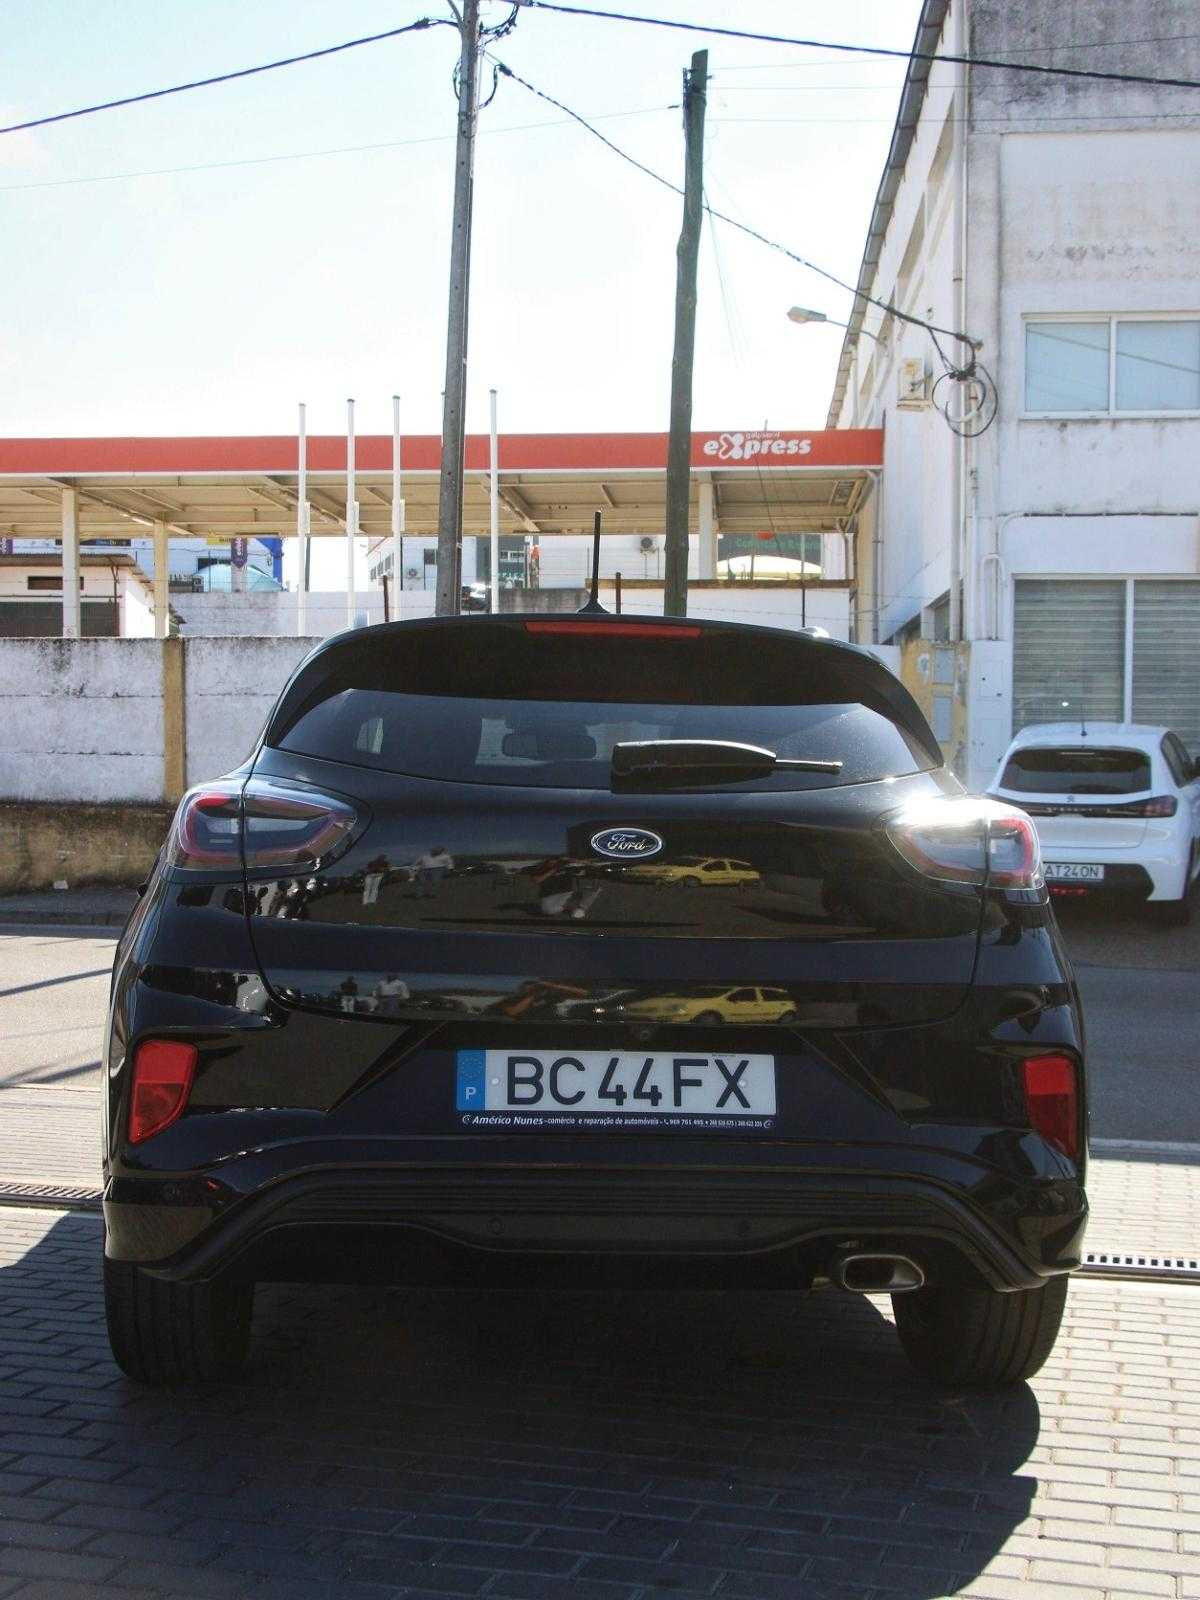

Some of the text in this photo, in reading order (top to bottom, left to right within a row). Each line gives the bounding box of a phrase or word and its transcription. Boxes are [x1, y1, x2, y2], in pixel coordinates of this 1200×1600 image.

[607, 833, 648, 851] Ford
[464, 1086, 477, 1100] P
[472, 1114, 511, 1125] Américo
[614, 1117, 624, 1126] de
